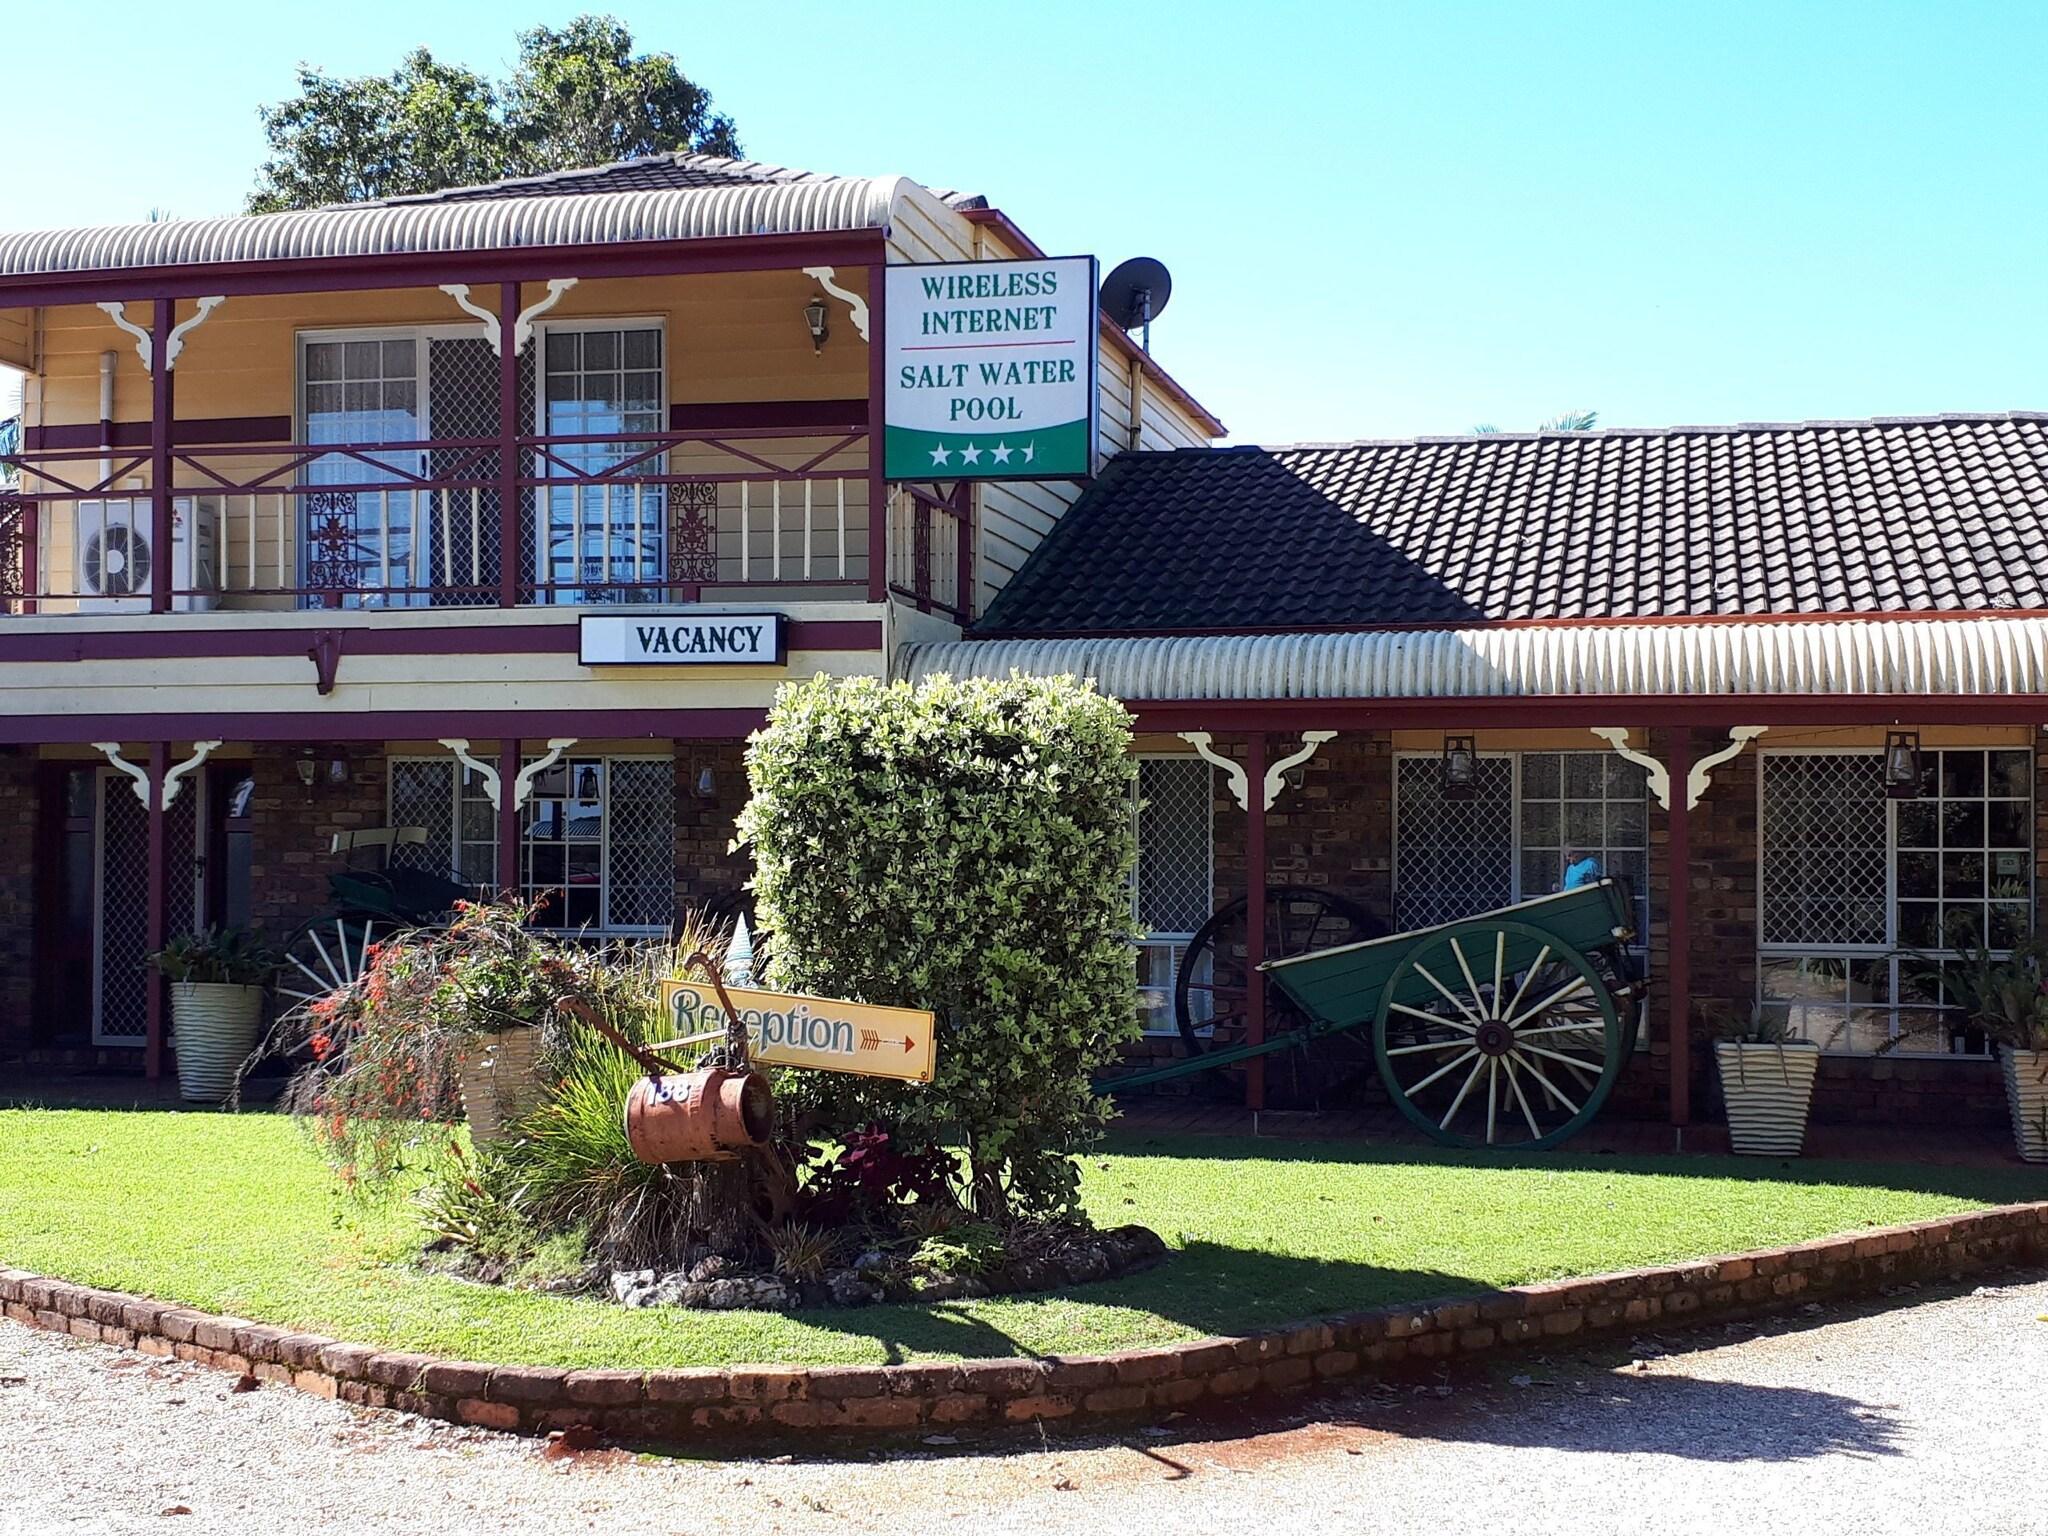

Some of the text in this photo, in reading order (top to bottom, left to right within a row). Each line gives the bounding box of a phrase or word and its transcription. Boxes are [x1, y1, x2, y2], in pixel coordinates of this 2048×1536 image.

[921, 271, 1058, 300] WIRELESS
[921, 306, 1057, 335] INTERNET
[900, 359, 1076, 389] SALT WATER
[949, 396, 1023, 421] POOL
[636, 626, 763, 654] VACANCY
